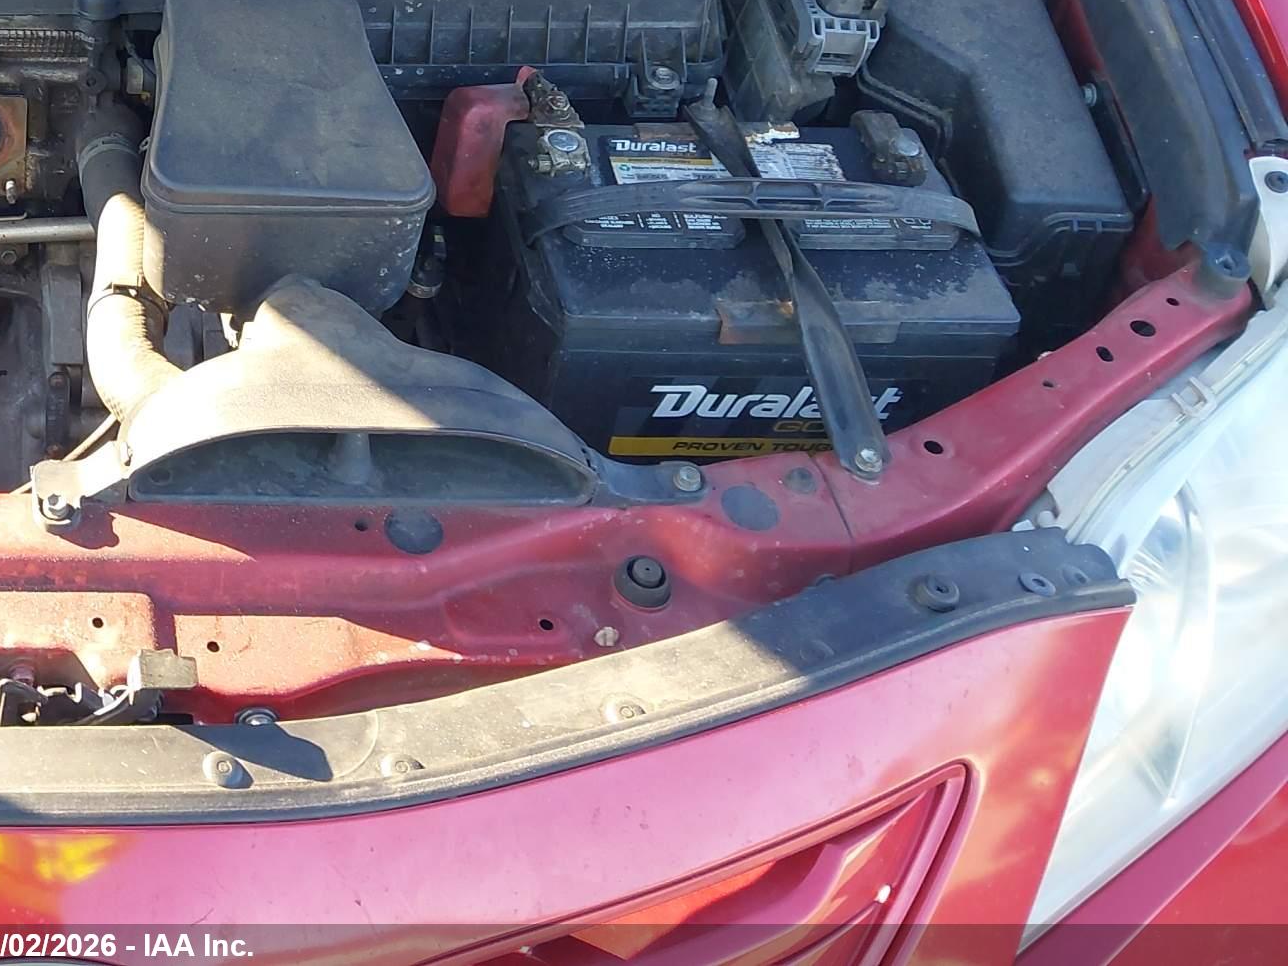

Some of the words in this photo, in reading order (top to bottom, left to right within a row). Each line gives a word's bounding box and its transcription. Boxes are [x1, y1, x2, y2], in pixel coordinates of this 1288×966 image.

[611, 139, 697, 153] Duralast
[650, 385, 903, 419] Duralt
[773, 420, 825, 433] GO
[671, 441, 765, 452] PROVEN
[772, 441, 834, 452] TOUG
